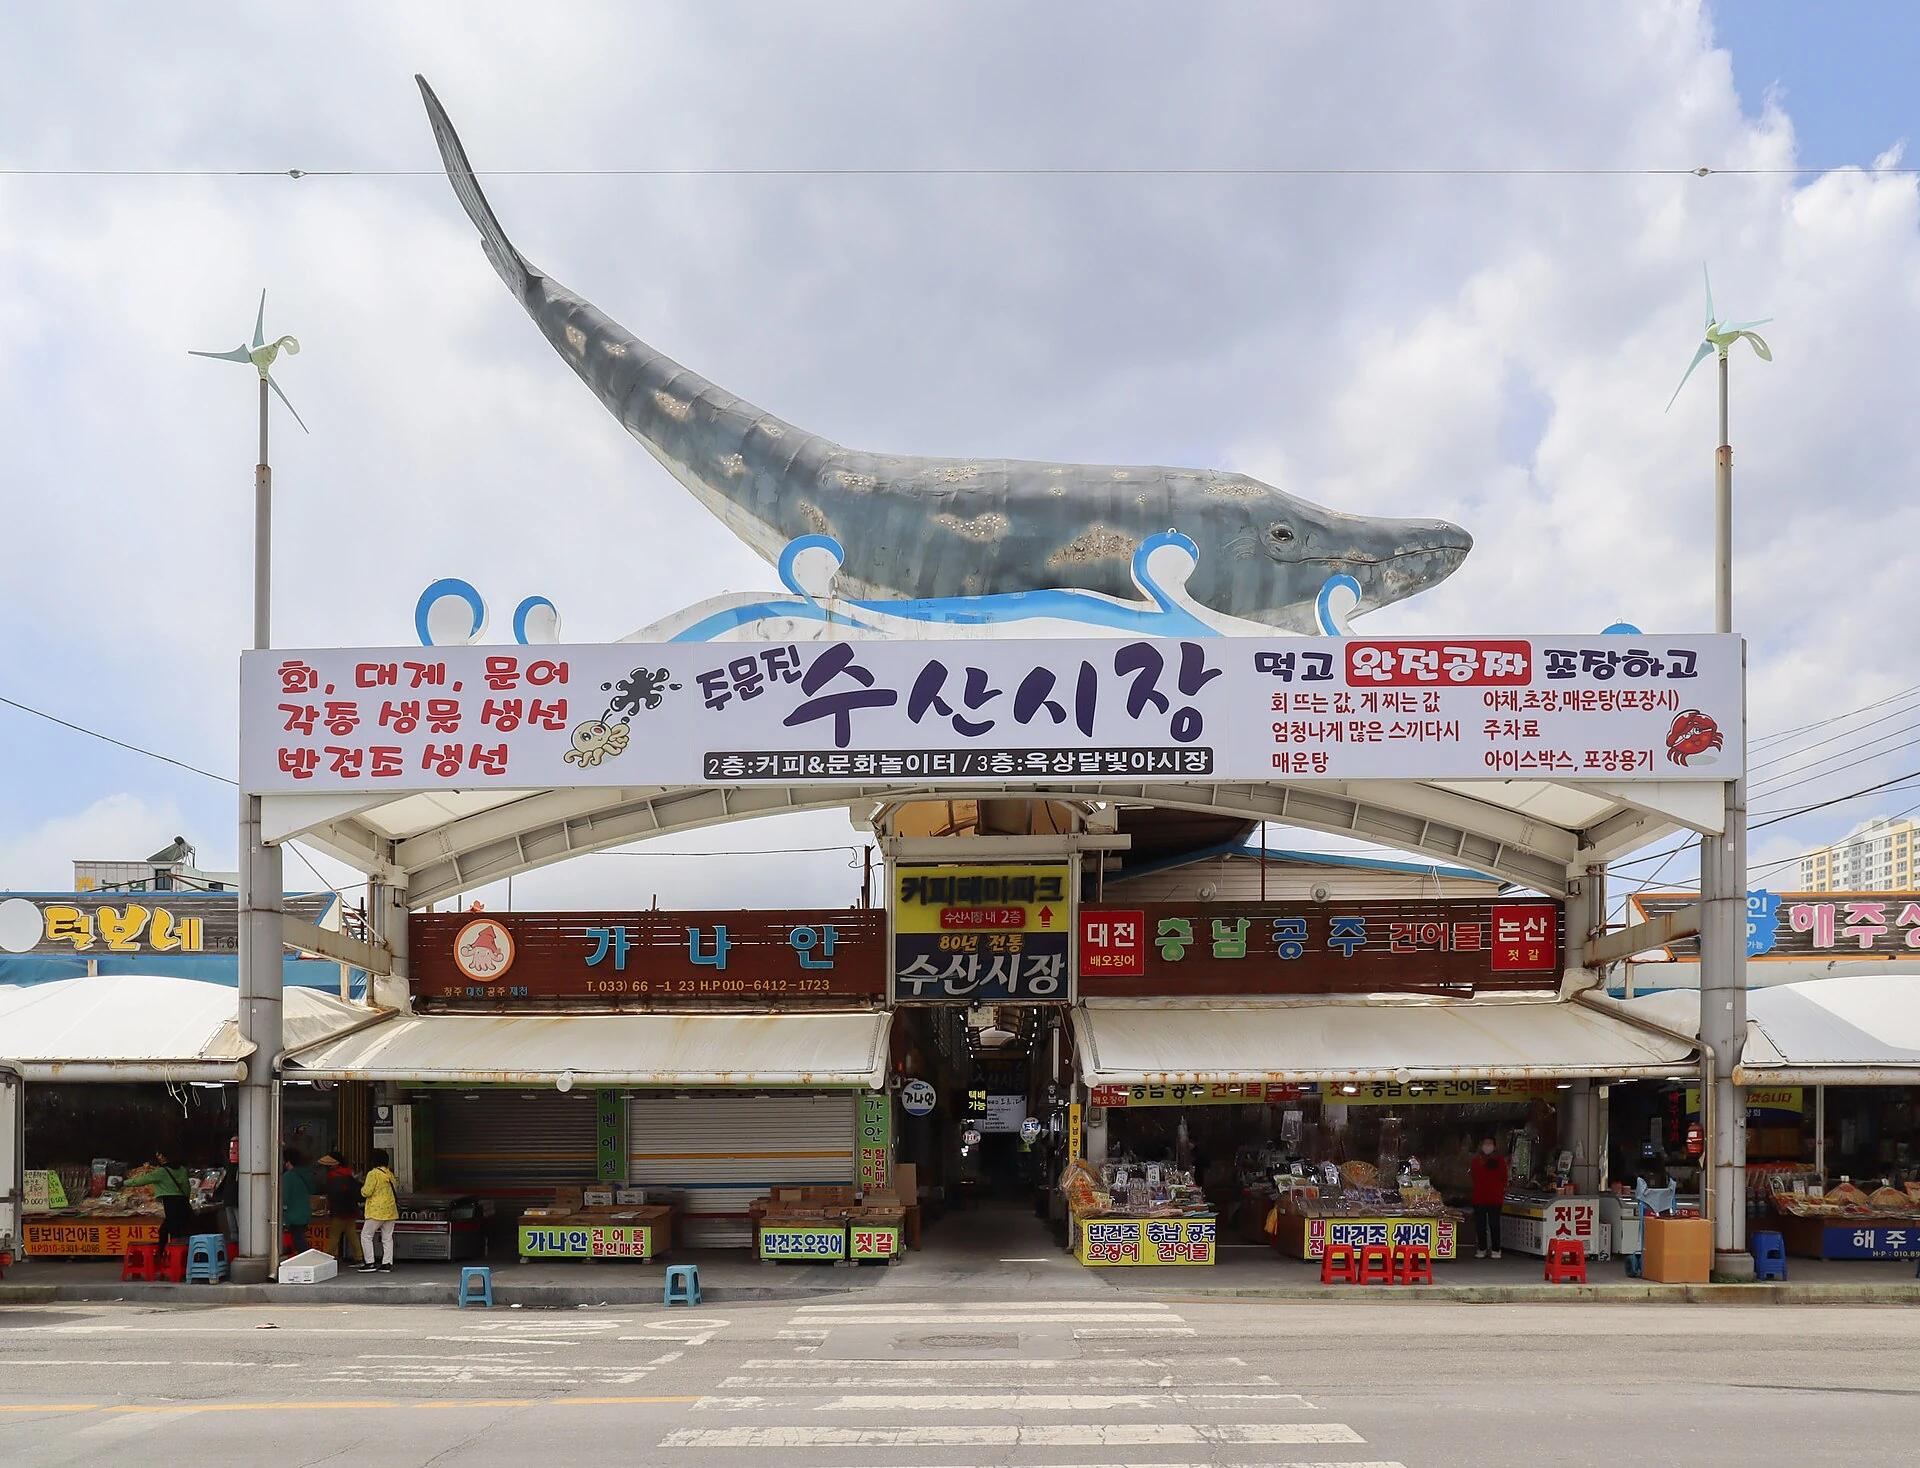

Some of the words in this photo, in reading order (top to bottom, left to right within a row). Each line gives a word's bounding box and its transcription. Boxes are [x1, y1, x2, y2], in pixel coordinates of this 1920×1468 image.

[277, 660, 334, 695] 회,
[355, 661, 463, 692] 대게,
[483, 655, 569, 691] 문어
[1254, 651, 1334, 683] 먹고
[1350, 646, 1528, 684] 완전공짜
[1543, 647, 1699, 681] 포장하고
[696, 643, 802, 713] 주문진
[782, 641, 1223, 749] 수산시장
[1271, 690, 1288, 714] 회
[1293, 691, 1328, 714] 뜨는
[1334, 691, 1356, 715] 값,
[1361, 690, 1379, 714] 게
[1382, 690, 1418, 714] 찌는
[1422, 690, 1441, 714] 값
[276, 702, 361, 737] 각종
[378, 700, 462, 736] 생물
[480, 697, 568, 732] 생선
[1271, 719, 1344, 744] 엄청나게
[1348, 719, 1385, 743] 많은
[1388, 718, 1461, 743] 스끼다시
[1483, 718, 1541, 740] 주차료
[277, 745, 403, 780] 반건조
[421, 742, 508, 777] 생선
[708, 753, 956, 777] 2층:커피&문화놀이터
[977, 750, 1209, 775] 3층:옥상달빛야시장
[1271, 750, 1330, 774] 매운탕
[1484, 749, 1579, 773] 아이스박스,
[1583, 749, 1655, 772] 포장용기
[944, 910, 984, 924] 수산시장
[985, 911, 996, 924] 내
[1000, 910, 1022, 924] 2층
[1087, 922, 1135, 948] 대전
[1155, 917, 1250, 961] 충남
[1272, 917, 1367, 960] 공주
[1389, 922, 1482, 954] 건어물
[1498, 917, 1548, 942] 논산
[939, 934, 979, 951] 80년
[988, 934, 1023, 952] 전통
[1090, 955, 1135, 967] 배오징어
[1508, 949, 1540, 961] 젓갈
[896, 953, 1066, 996] 수산시장
[904, 1092, 934, 1106] 가나안
[968, 1090, 986, 1100] 택배
[968, 1100, 986, 1111] 가능
[863, 1100, 883, 1142] 가나안
[1554, 1206, 1594, 1236] 젓갈
[29, 1227, 100, 1243] 털보네건어물
[526, 1231, 589, 1253] 가나안
[592, 1229, 644, 1242] 건어물
[855, 1233, 893, 1253] 젓갈
[1088, 1223, 1140, 1242] 반건조
[1147, 1223, 1183, 1243] 충남
[1309, 1219, 1326, 1256] 대전
[592, 1242, 645, 1256] 할인매장
[764, 1234, 843, 1254] 반건조오징어
[1088, 1242, 1140, 1262] 오징어
[1158, 1242, 1209, 1262] 건어물
